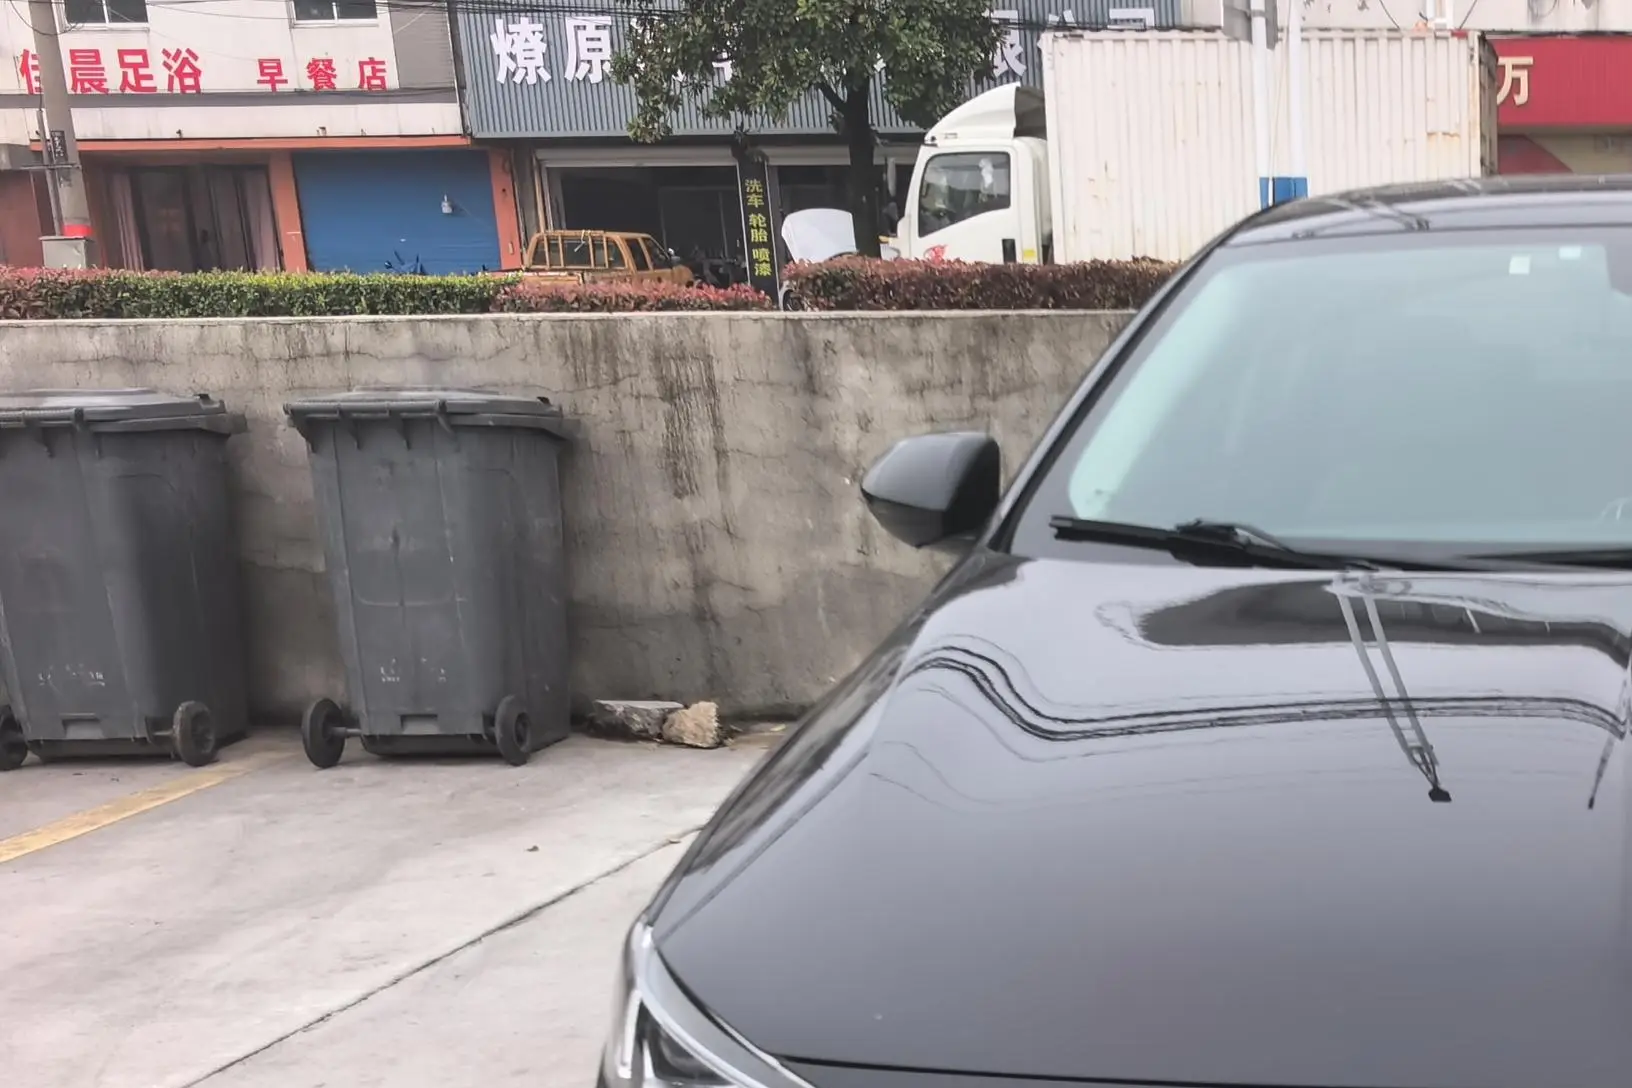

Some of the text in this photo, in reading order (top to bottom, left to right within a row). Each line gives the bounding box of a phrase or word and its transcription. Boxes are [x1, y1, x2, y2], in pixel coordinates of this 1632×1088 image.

[257, 57, 388, 93] 早餐店
[745, 179, 772, 276] 洗车 轮胎 喷漆
